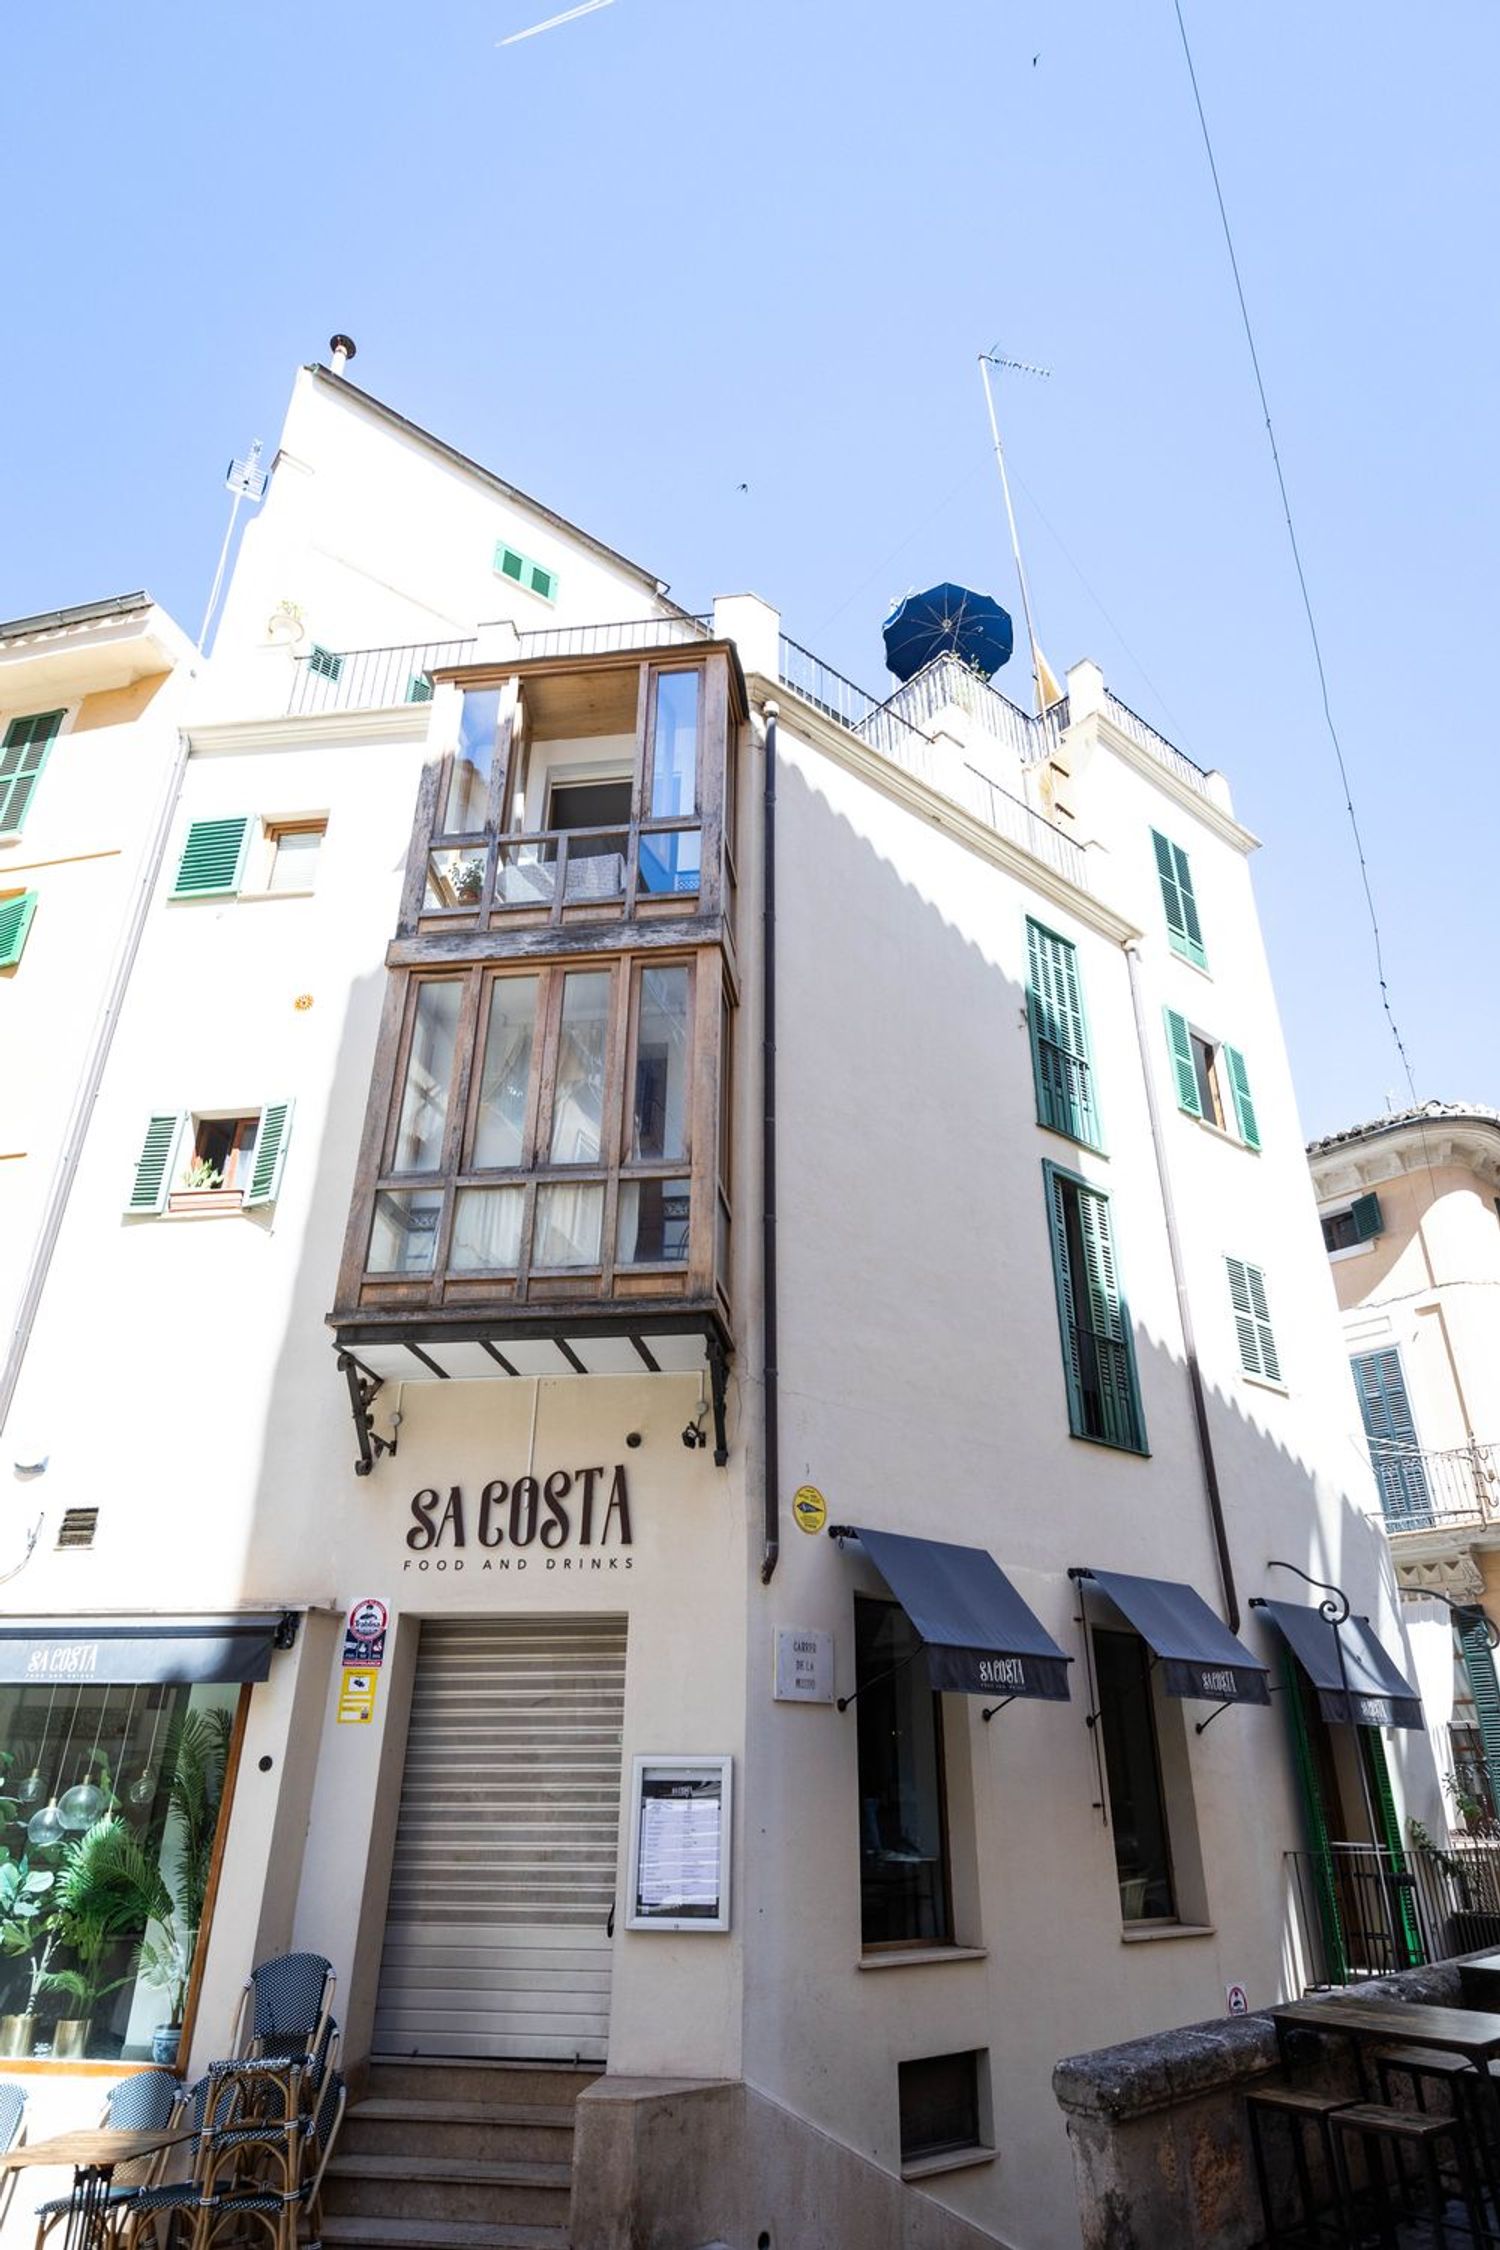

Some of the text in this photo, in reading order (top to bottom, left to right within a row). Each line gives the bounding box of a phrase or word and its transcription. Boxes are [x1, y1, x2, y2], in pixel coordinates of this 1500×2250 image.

[406, 1464, 633, 1550] SA COSTA
[403, 1557, 633, 1571] FOOD AND DRINKS
[27, 1644, 98, 1672] SA COSTA
[793, 1640, 817, 1653] CARRER
[979, 1658, 1025, 1684] SA COSTA
